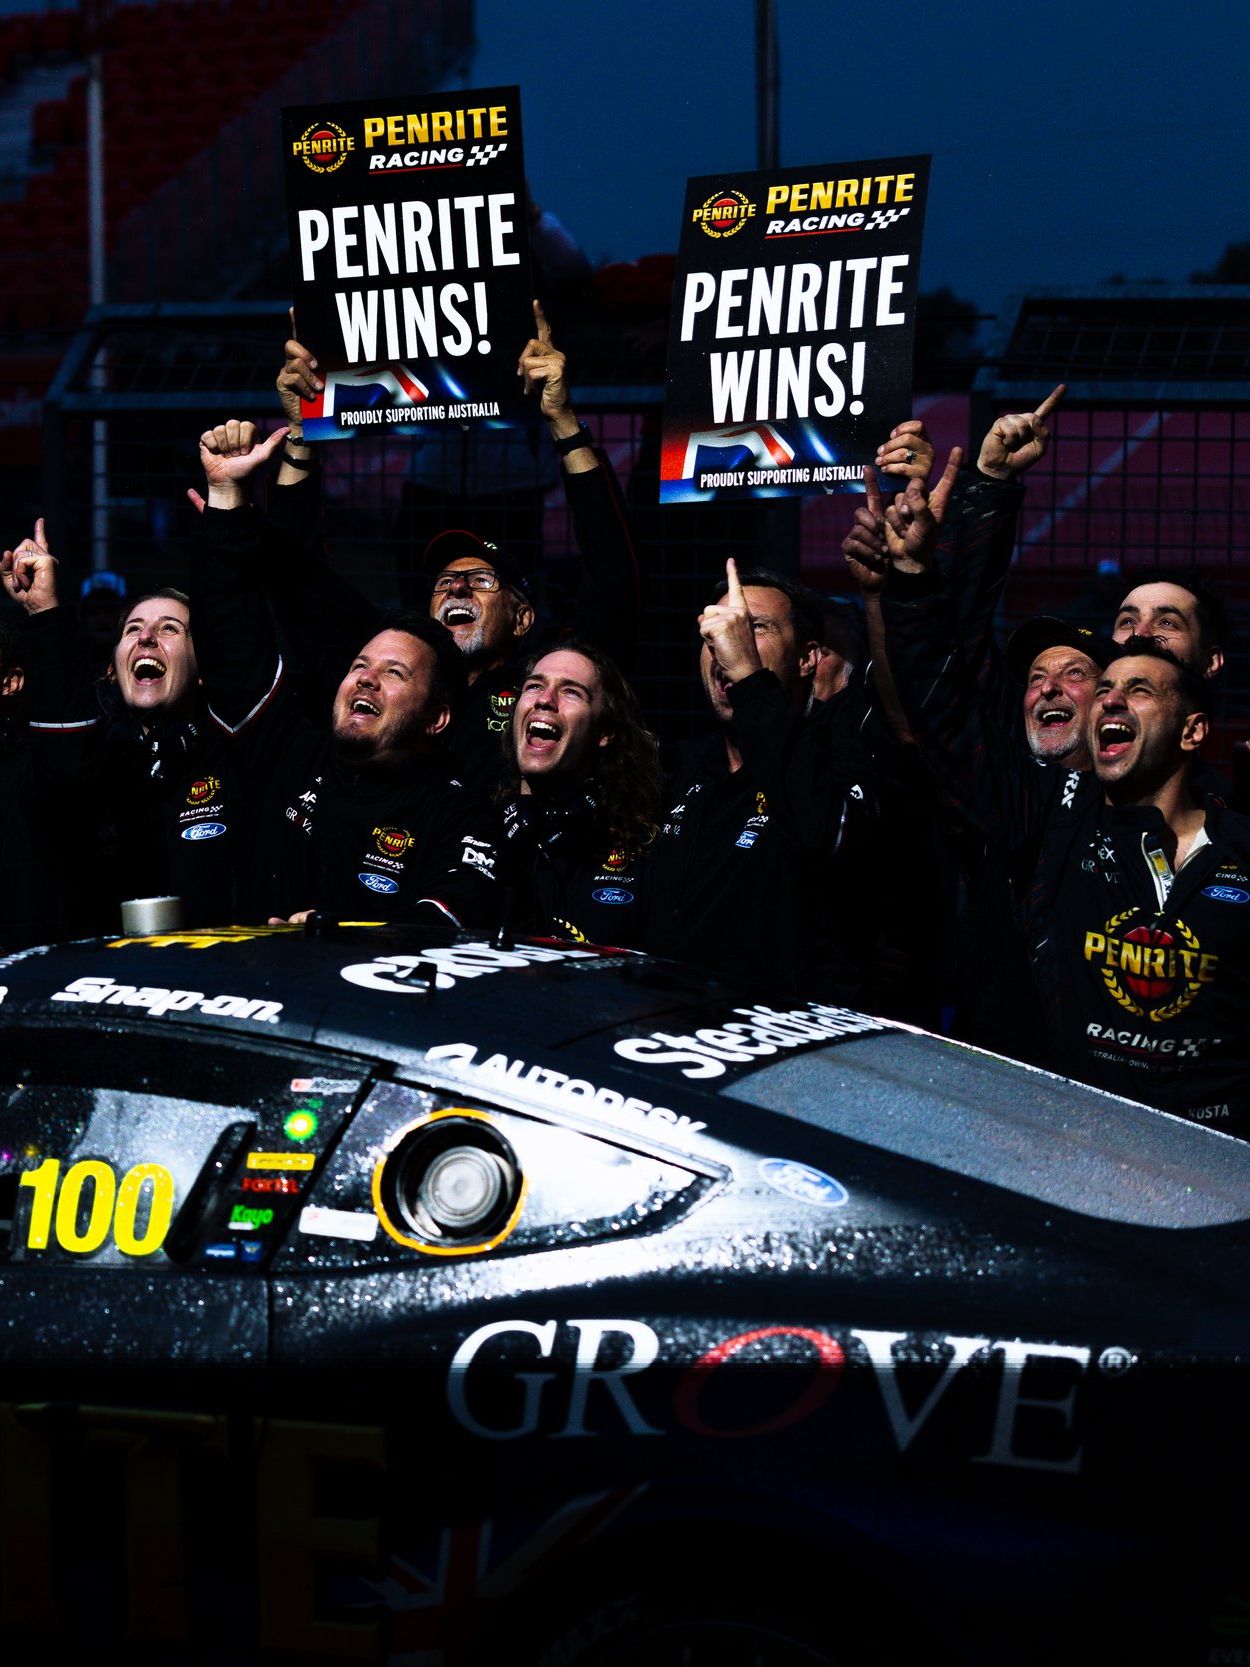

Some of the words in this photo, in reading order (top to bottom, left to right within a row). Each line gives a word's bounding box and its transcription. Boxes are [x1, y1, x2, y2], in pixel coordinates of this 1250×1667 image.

[364, 106, 508, 148] PENRITE
[293, 135, 355, 156] PENRITE
[368, 145, 464, 170] RACING
[766, 173, 915, 214] PENRITE
[692, 200, 756, 222] PENRITE
[766, 212, 864, 235] RACING
[298, 193, 520, 281] PENRITE
[681, 254, 909, 342] PENRITE
[335, 281, 492, 363] WINS!
[710, 342, 866, 423] WINS!
[340, 408, 382, 426] PROUDLY
[384, 405, 446, 424] SUPPORTING
[447, 402, 500, 421] AUSTRALIA
[700, 471, 745, 488] PROUDLY
[747, 467, 810, 486] SUPPORTING
[180, 806, 210, 818] RACING
[190, 824, 219, 838] Ford
[371, 826, 416, 848] PENRITE
[366, 853, 394, 865] RACING
[365, 875, 392, 892] Ford
[1215, 872, 1238, 880] CING
[600, 890, 626, 902] Ford
[1210, 887, 1240, 902] Ford
[1084, 931, 1220, 983] PENRITE
[50, 977, 285, 1024] Snap-on
[1086, 1022, 1177, 1053] RACING
[478, 1053, 708, 1137] AUTODESK
[20, 1158, 174, 1256] 100
[231, 1204, 274, 1230] Kayo
[448, 1318, 1092, 1475] GROVE
